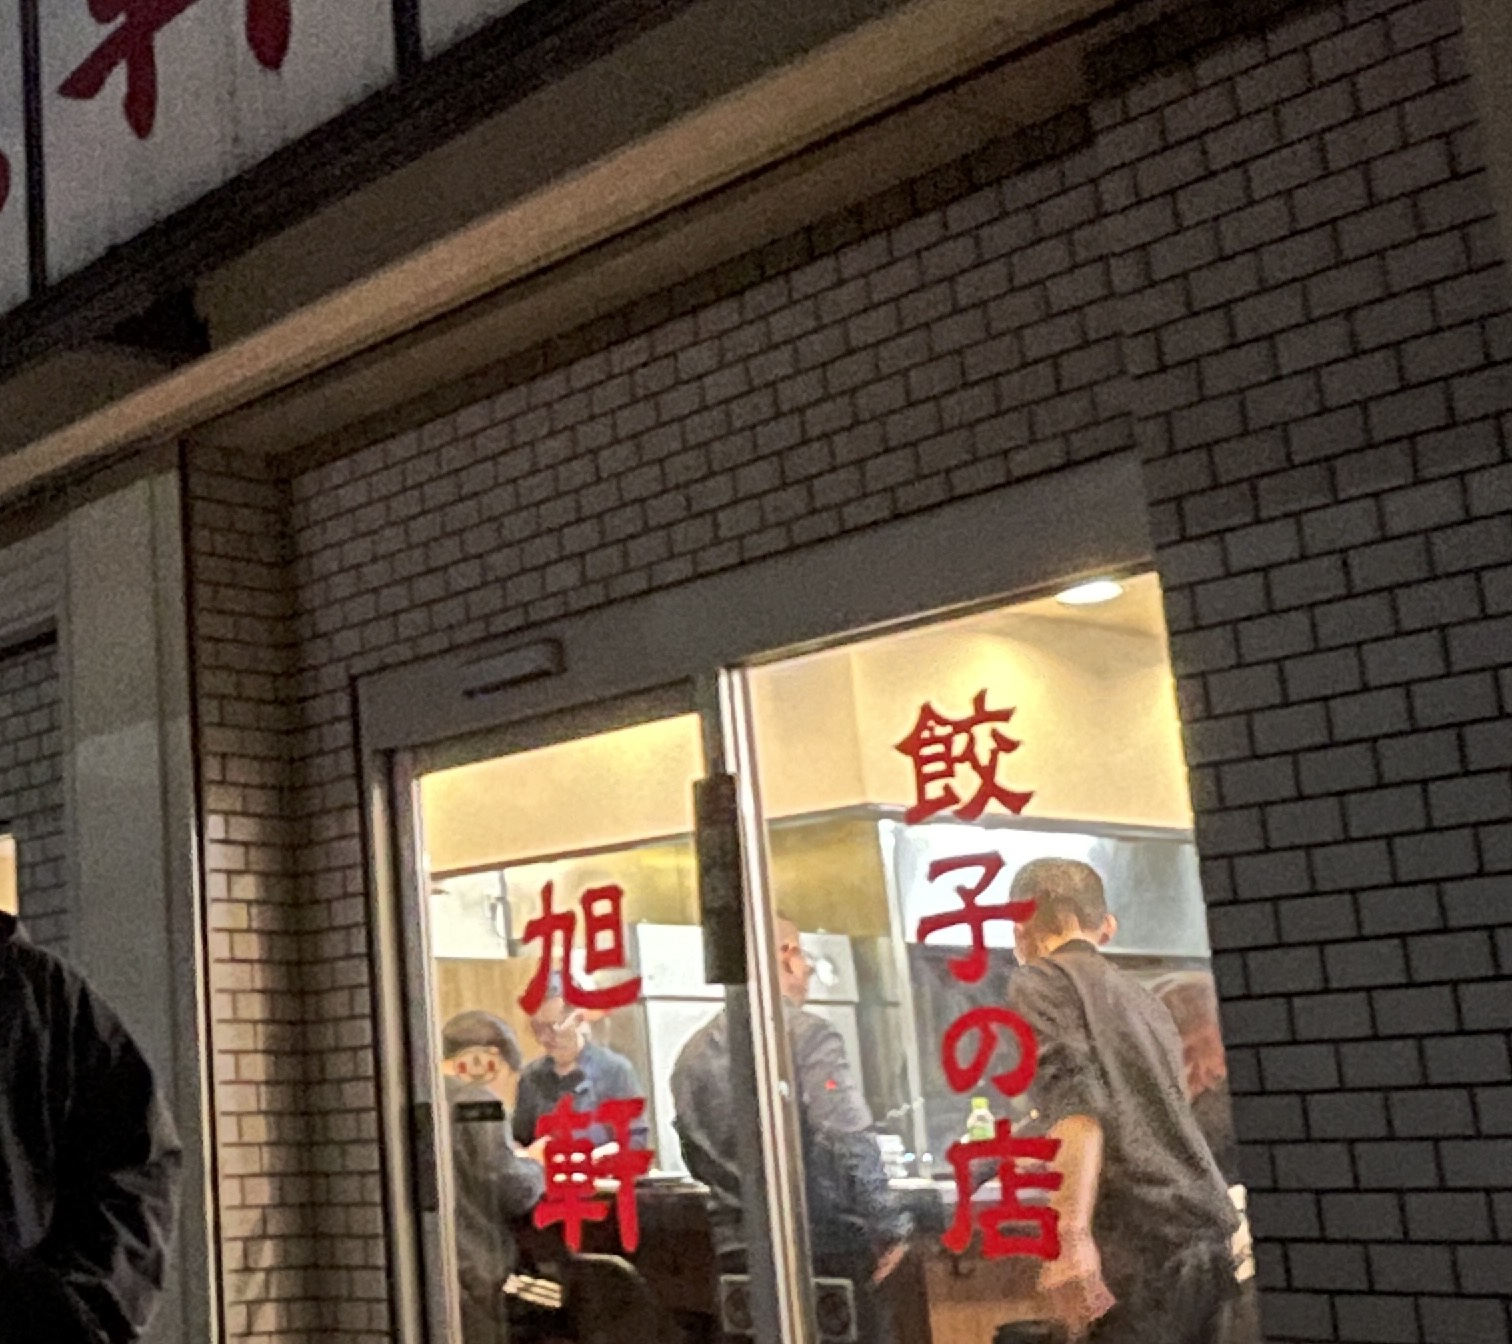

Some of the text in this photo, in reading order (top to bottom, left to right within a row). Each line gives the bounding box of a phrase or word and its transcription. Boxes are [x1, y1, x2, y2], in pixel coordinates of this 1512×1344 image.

[518, 879, 655, 1254] 旭軒
[892, 686, 1065, 1263] 餃子の店
